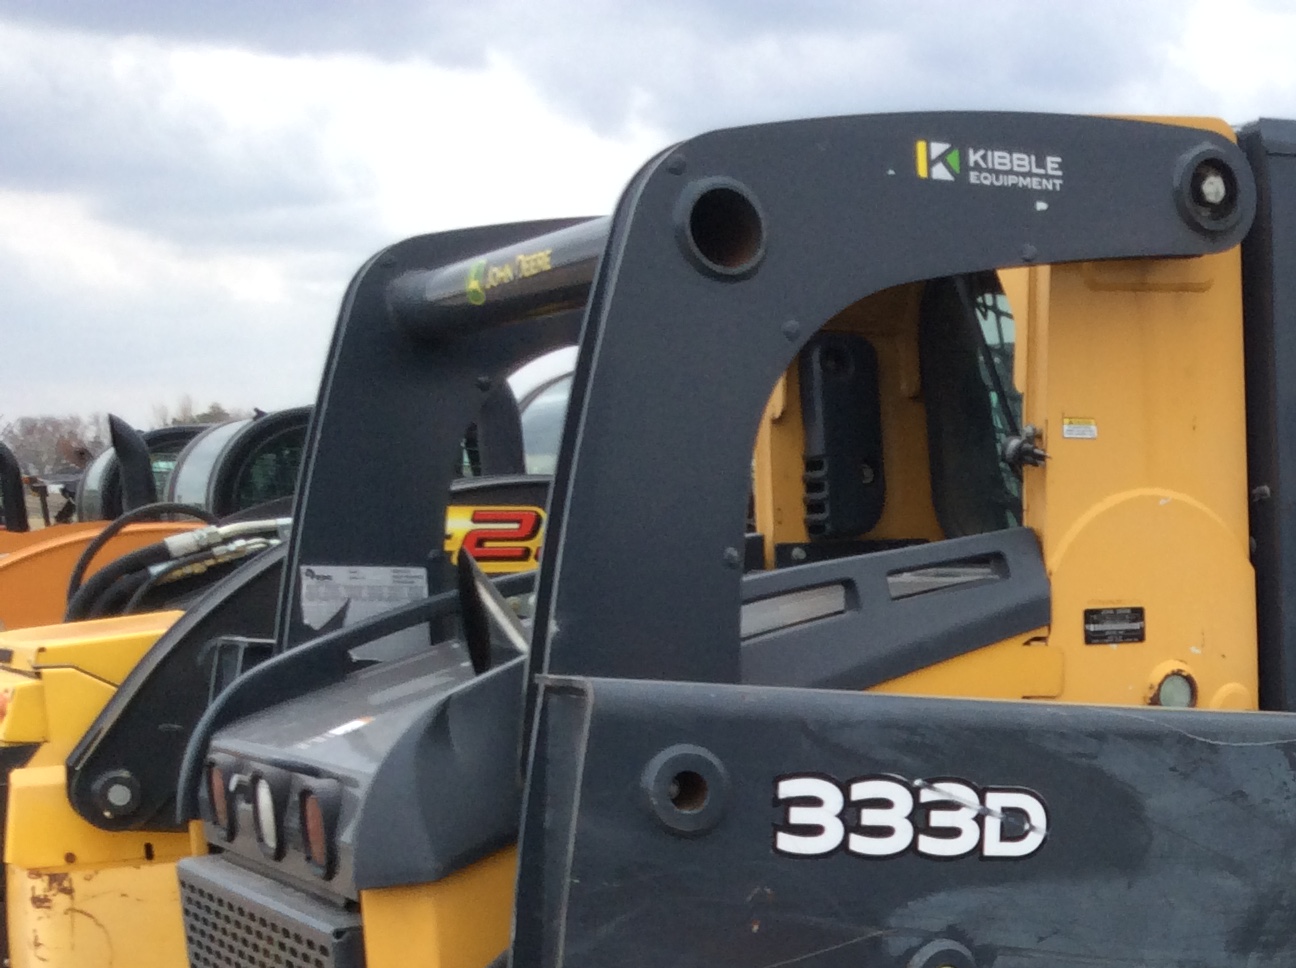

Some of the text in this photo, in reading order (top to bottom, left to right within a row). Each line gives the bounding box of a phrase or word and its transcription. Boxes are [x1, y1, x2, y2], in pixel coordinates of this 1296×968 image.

[967, 147, 1063, 176] KIBBLE
[969, 171, 1063, 191] EQUIPMENT
[774, 775, 1049, 858] 333D
